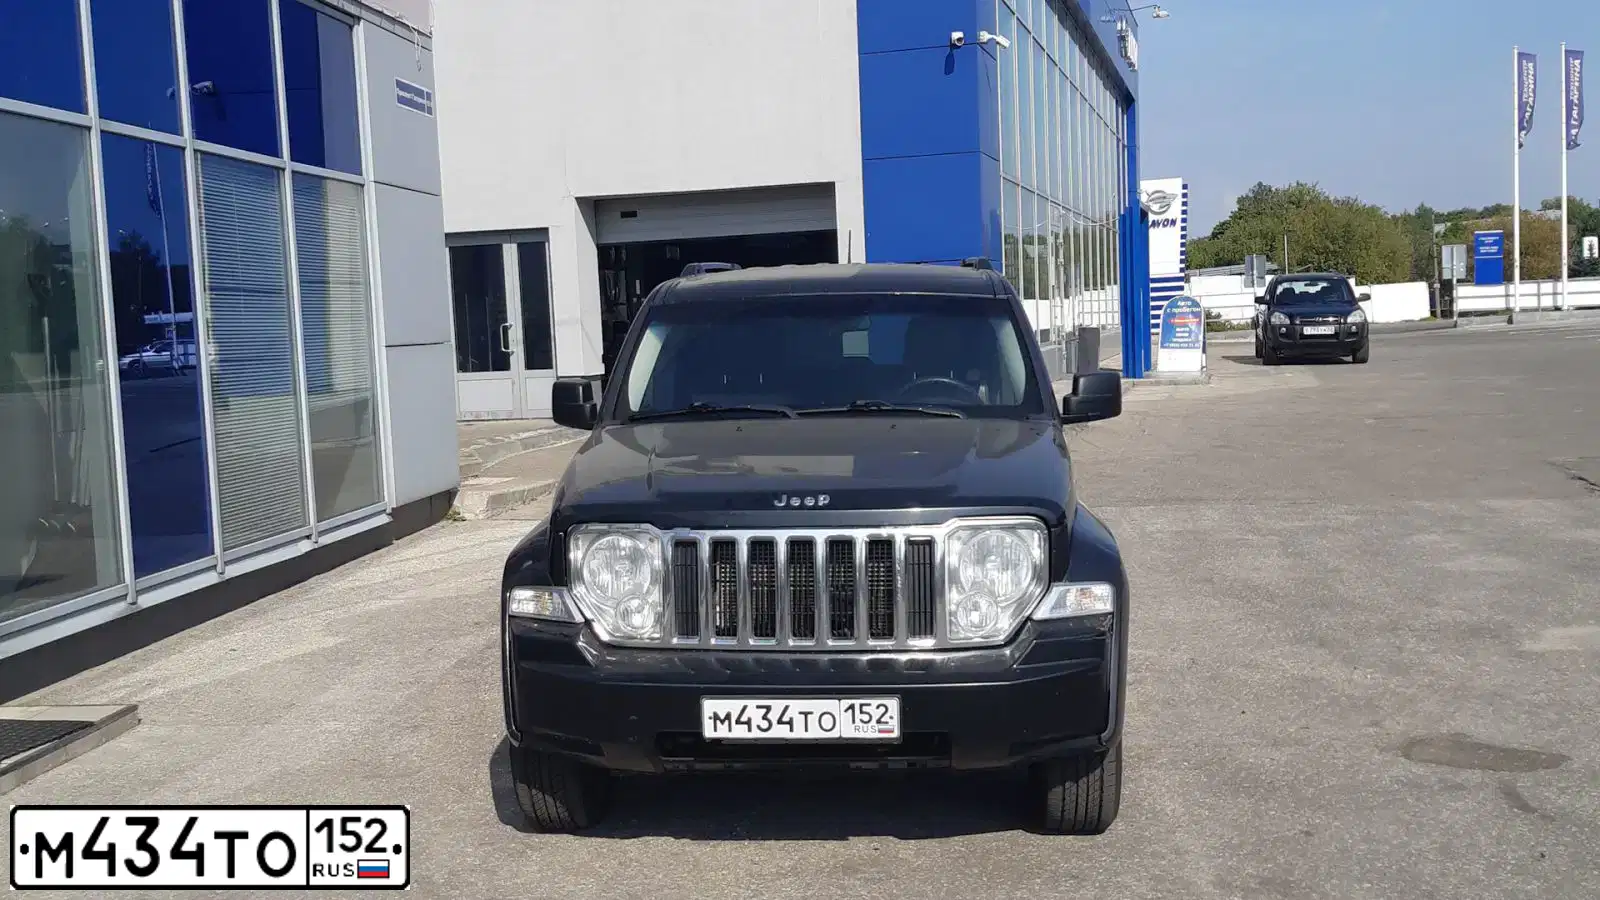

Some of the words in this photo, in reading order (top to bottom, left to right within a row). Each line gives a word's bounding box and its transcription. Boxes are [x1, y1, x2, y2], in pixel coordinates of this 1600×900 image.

[1149, 217, 1178, 229] AVON
[774, 494, 831, 507] Jeep
[844, 703, 889, 724] 152
[854, 725, 877, 734] RUS
